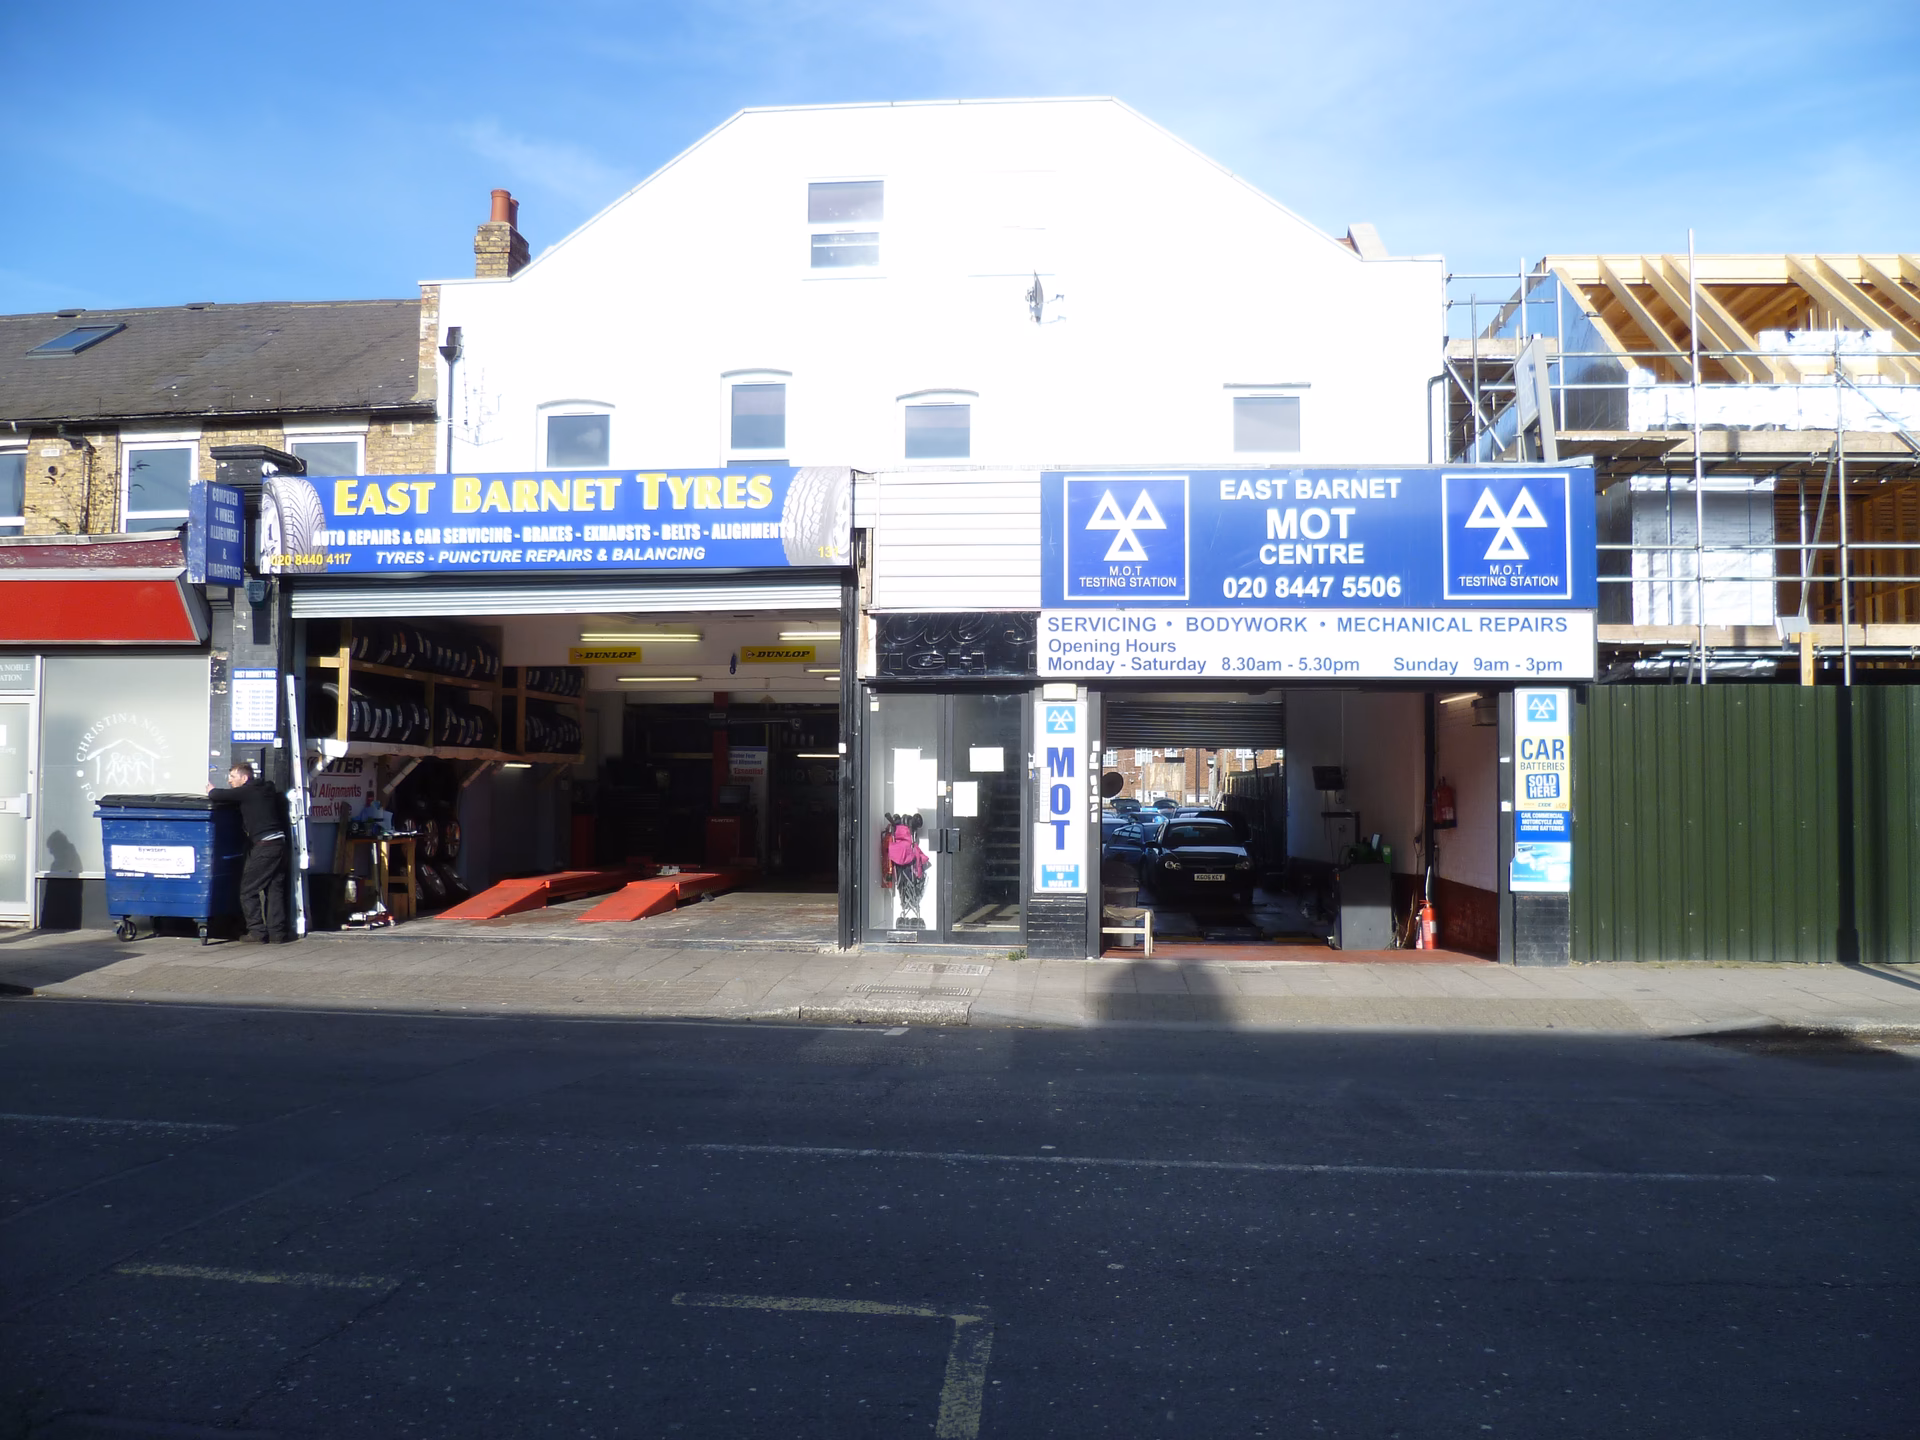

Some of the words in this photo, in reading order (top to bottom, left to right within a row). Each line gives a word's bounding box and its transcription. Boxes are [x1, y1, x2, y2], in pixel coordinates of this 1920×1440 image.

[212, 487, 238, 506] COMPUTER
[333, 479, 436, 516] EAST
[452, 477, 622, 513] BARNET
[636, 472, 773, 511] TYRES
[1220, 479, 1287, 500] EAST
[1295, 478, 1401, 500] BARNET
[1266, 507, 1355, 540] MOT
[313, 529, 345, 547] AUTO
[349, 529, 401, 546] REPAIRS
[402, 532, 412, 545] &
[415, 528, 441, 545] CAR
[443, 527, 512, 545] SERVICING
[523, 526, 573, 543] BRAKES
[584, 524, 650, 542] EXHAUSTS
[661, 523, 701, 541] BELTS
[711, 522, 796, 540] ALIGNMENTS
[271, 554, 291, 566] 020
[295, 553, 323, 566] 8440
[326, 552, 352, 565] 4117
[376, 551, 425, 565] TYRES
[438, 549, 523, 564] PUNCTURE
[524, 548, 593, 563] REPAIRS
[596, 549, 608, 561] &
[612, 547, 706, 562] BALANCING
[817, 546, 839, 559] 131
[1259, 543, 1365, 565] CENTRE
[208, 562, 241, 580] DIAGNOSTICS
[1109, 566, 1142, 576] M.O.T
[1489, 565, 1523, 575] M.O.T
[1079, 577, 1126, 587] TESTING
[1129, 577, 1177, 587] STATION
[1223, 577, 1267, 598] 020
[1275, 577, 1334, 598] 8447
[1342, 577, 1401, 598] 5506
[1459, 576, 1506, 587] TESTING
[1510, 576, 1558, 587] STATION
[1048, 617, 1157, 632] SERVICING
[1186, 617, 1308, 632] BODYWORK
[1337, 617, 1472, 632] MECHANICAL
[1479, 617, 1567, 632] REPAIRS
[584, 651, 637, 659] DUNLOP
[756, 650, 810, 658] DUNLOP
[1048, 638, 1120, 655] Opening
[1126, 638, 1176, 652] Hours
[1048, 657, 1115, 674] Monday
[1131, 657, 1206, 674] Saturday
[1222, 657, 1282, 671] 8.30am
[1299, 657, 1360, 674] 5.30pm
[1394, 657, 1459, 675] Sunday
[1473, 657, 1509, 671] 9am
[1526, 657, 1563, 674] 3pm
[76, 713, 137, 762] CHRISTINA
[1521, 738, 1565, 760] CAR
[1520, 762, 1565, 771] BATTERIES
[1528, 774, 1557, 787] SOLD
[319, 784, 361, 801] Alignments
[1529, 785, 1557, 798] HERE
